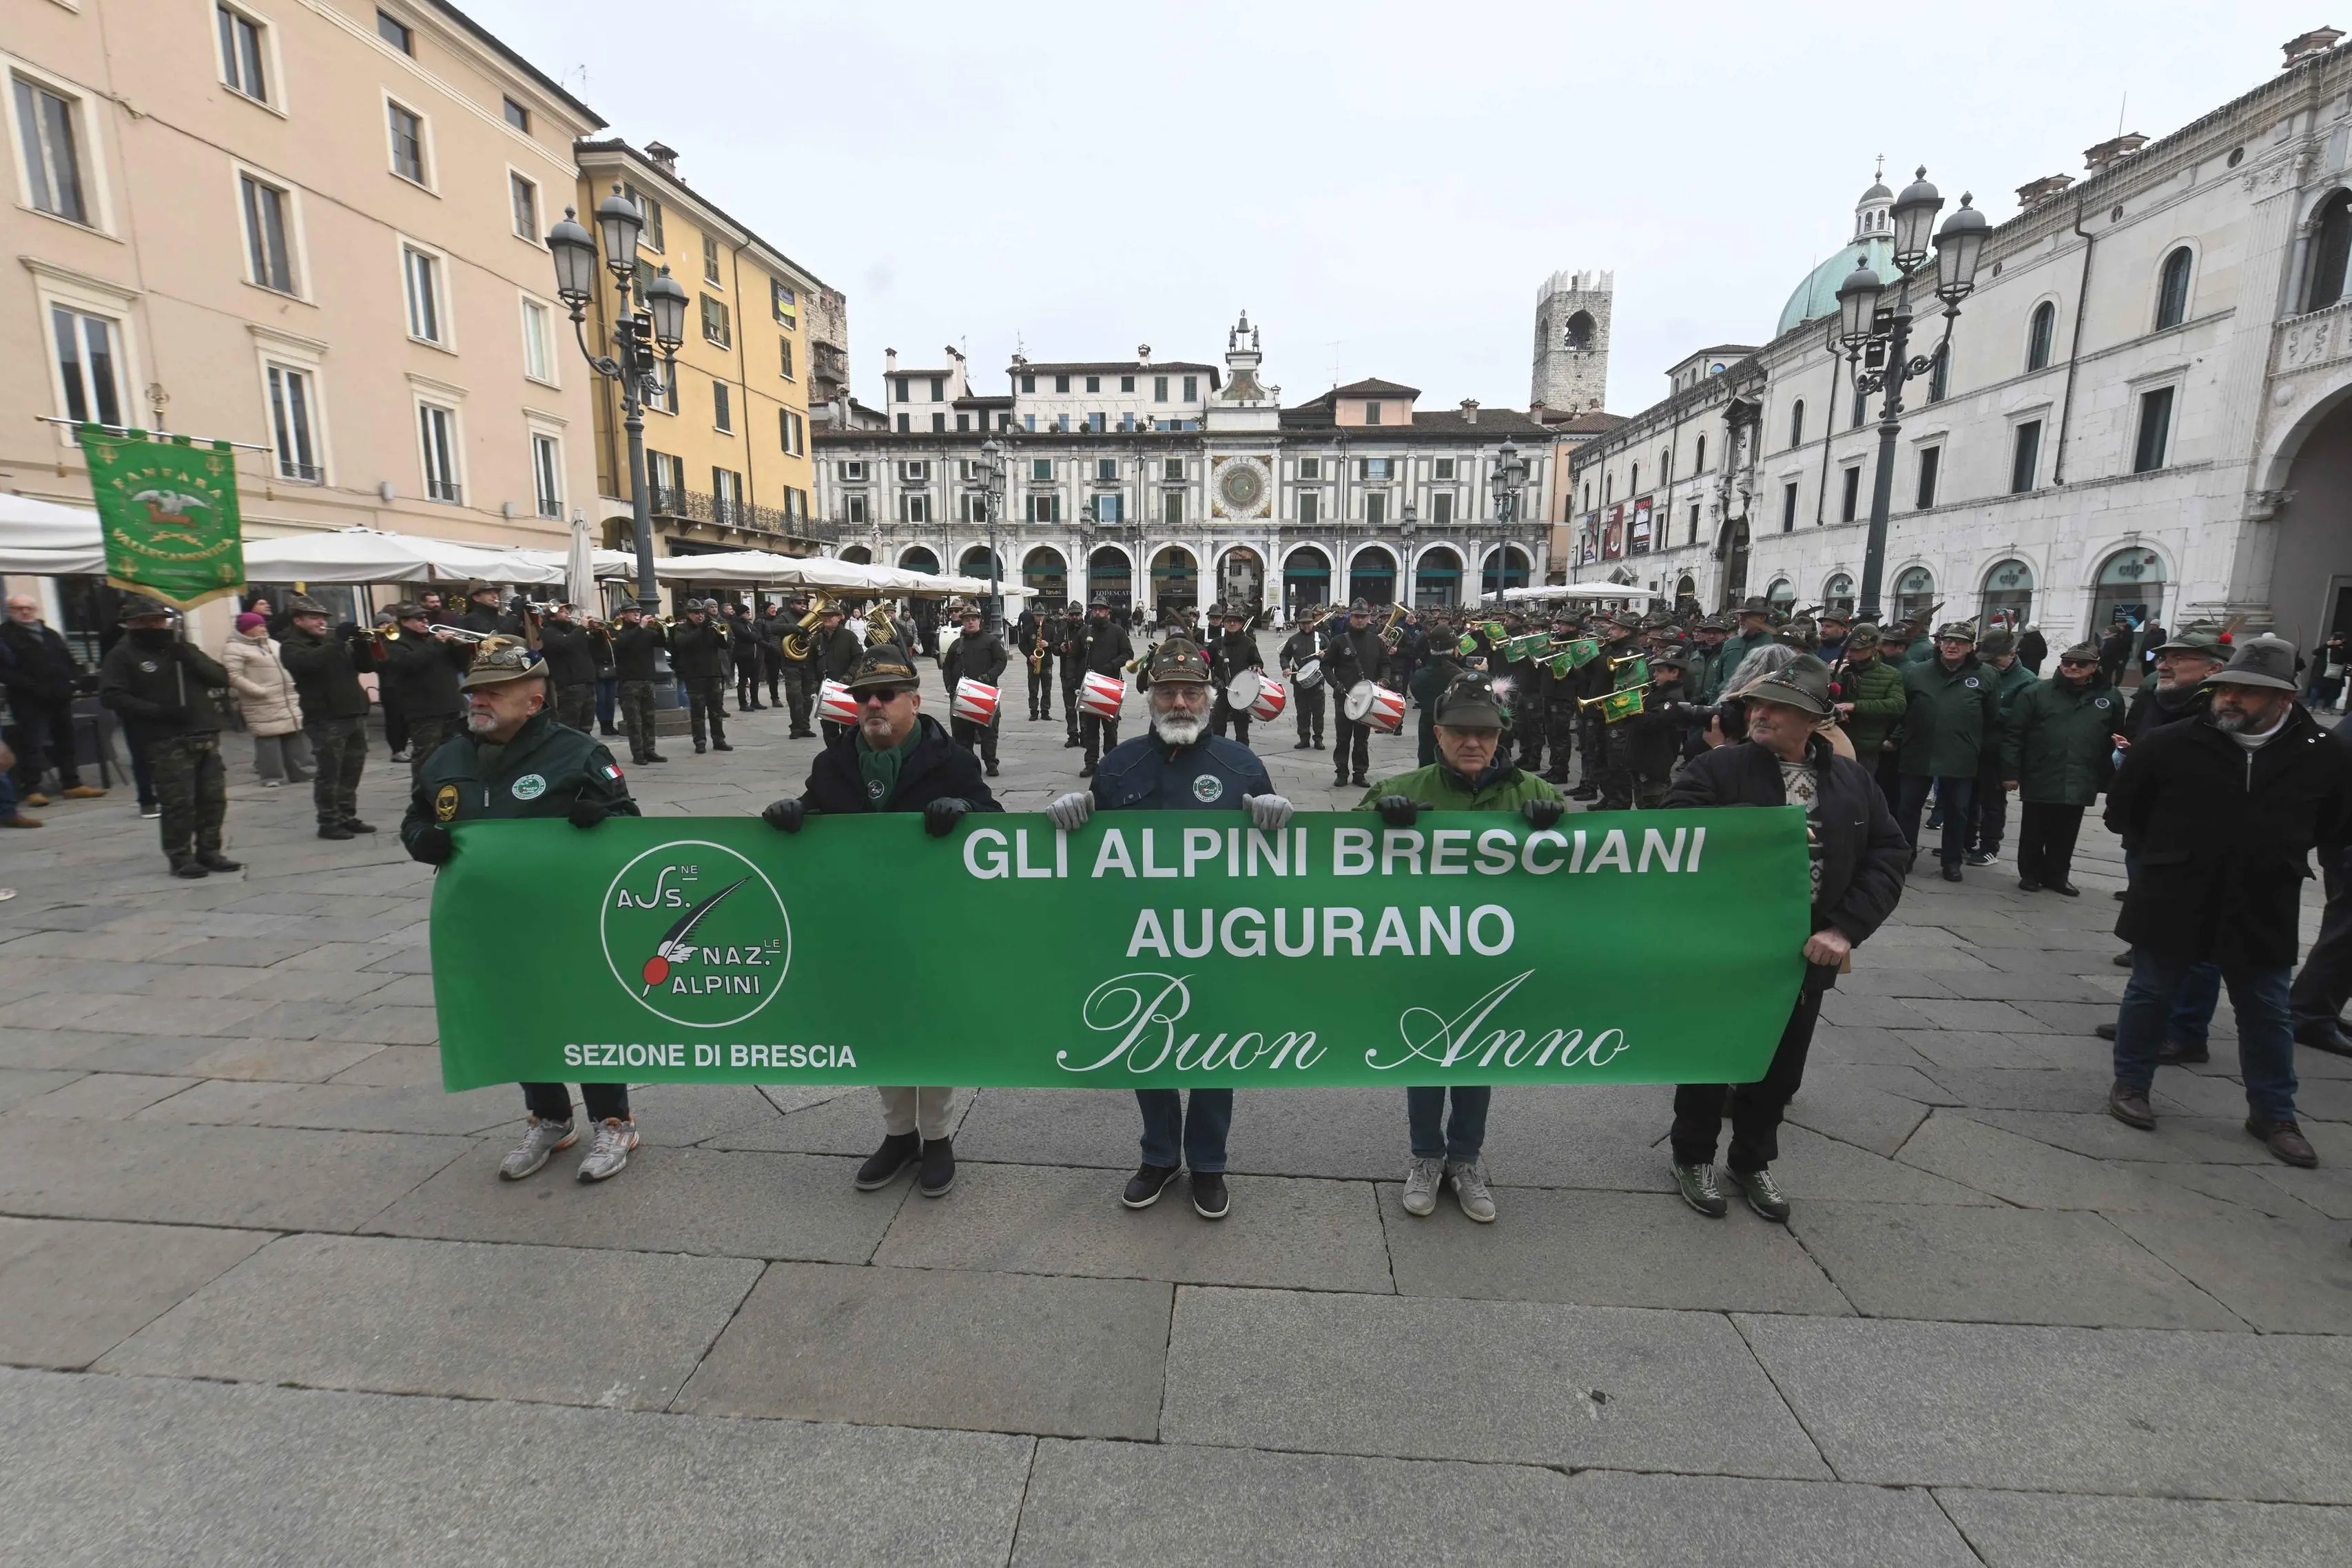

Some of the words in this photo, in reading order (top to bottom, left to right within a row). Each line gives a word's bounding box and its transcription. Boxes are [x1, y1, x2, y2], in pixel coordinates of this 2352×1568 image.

[112, 468, 221, 497] FANFARA
[963, 827, 1068, 879] GLI
[1091, 827, 1307, 878] ALPINI
[1334, 827, 1706, 876] BRESCIANI
[1126, 904, 1515, 958] AUGURANO
[672, 976, 760, 994] ALPINI
[1057, 972, 1328, 1073] Buon
[1365, 969, 1630, 1069] Anno
[564, 1044, 685, 1066] SEZIONE
[694, 1044, 721, 1066] DI
[730, 1044, 857, 1068] BRESCIA
